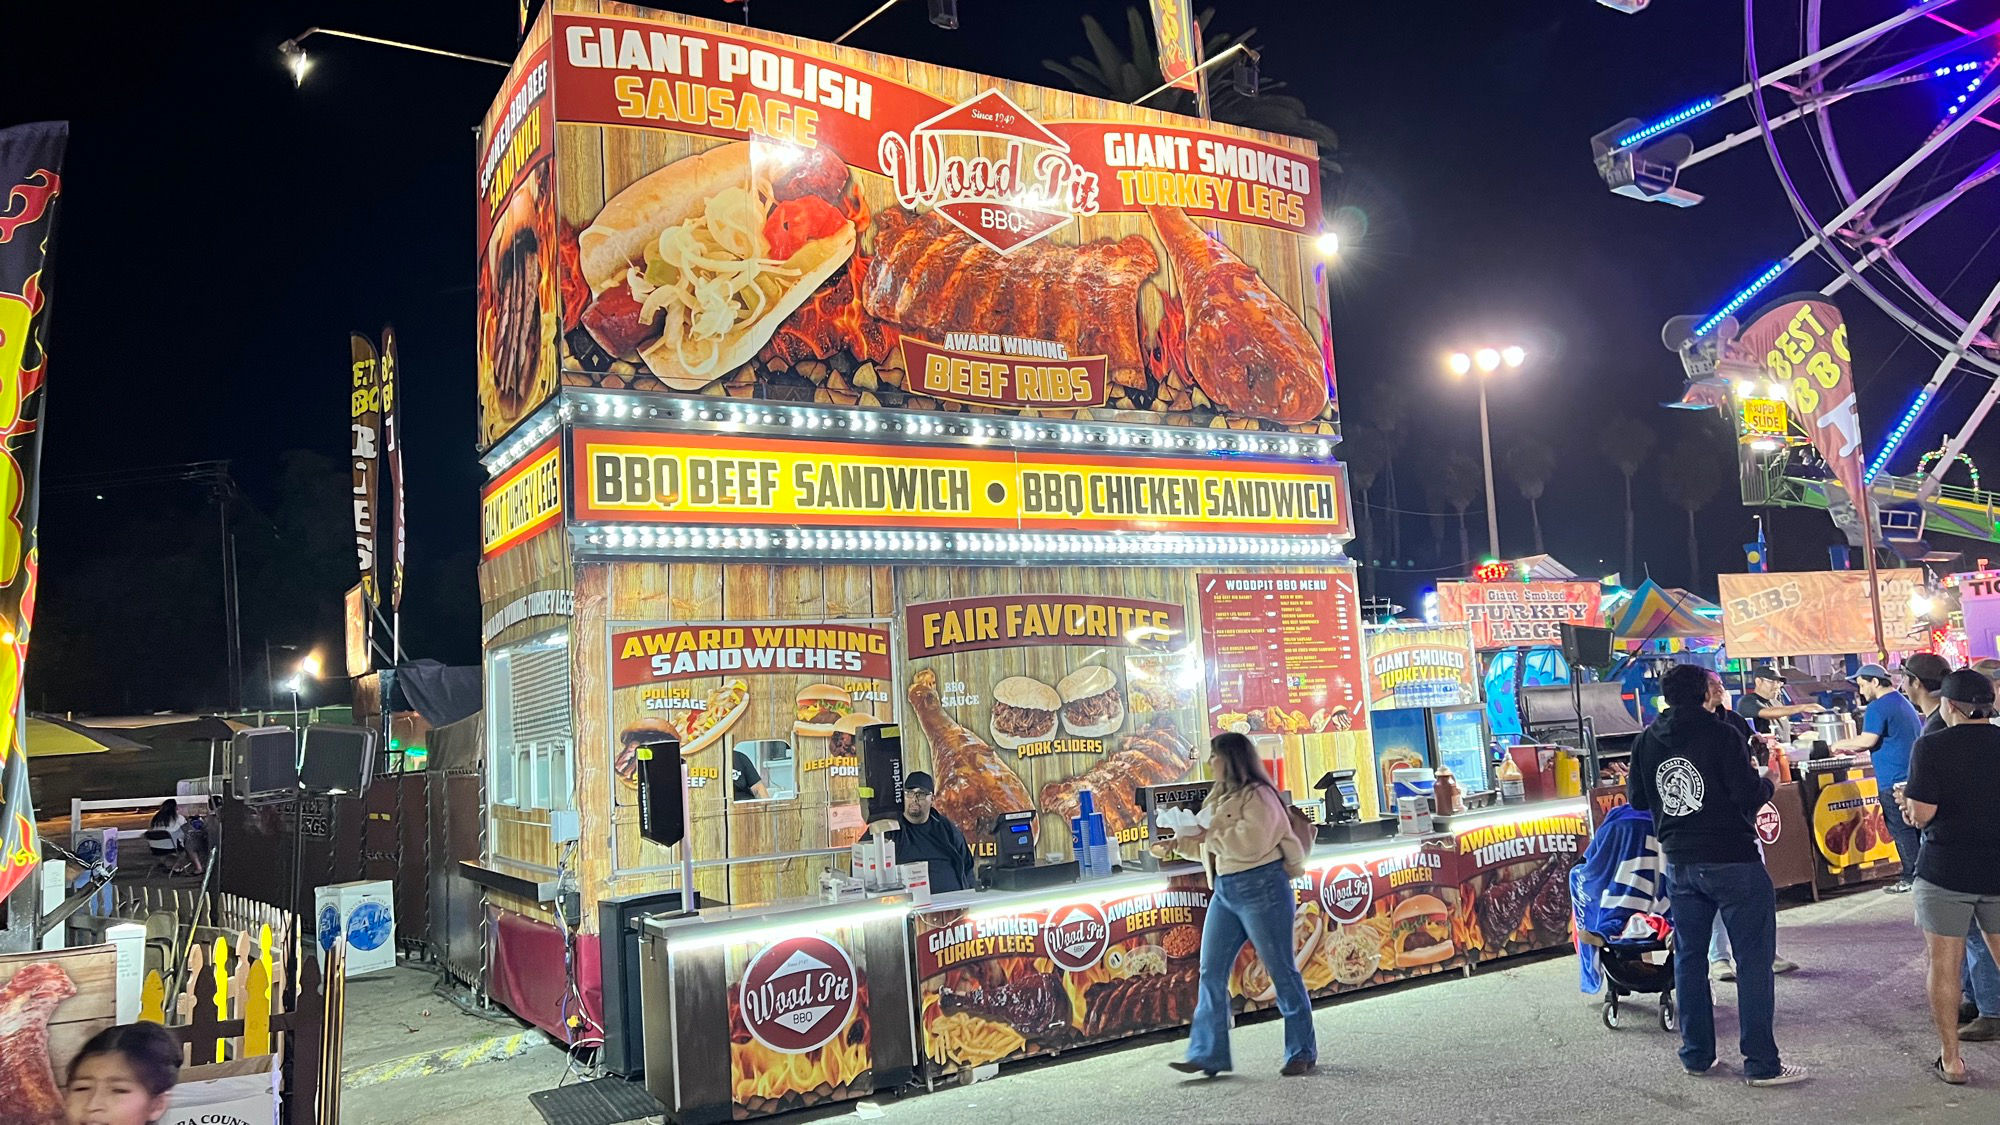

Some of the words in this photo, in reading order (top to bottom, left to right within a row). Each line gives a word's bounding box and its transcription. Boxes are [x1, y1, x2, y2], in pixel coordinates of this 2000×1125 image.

[565, 25, 709, 78] GIANT
[718, 43, 873, 120] POLISH
[614, 76, 819, 149] SAUSAGE
[971, 108, 993, 120] Since
[481, 113, 511, 199] SMOKED
[510, 84, 527, 132] BBQ
[528, 59, 548, 105] BEEF
[490, 106, 540, 219] SANDWICH
[878, 131, 1025, 210] Wood
[1034, 151, 1099, 216] Pit
[1104, 132, 1191, 168] GIANT
[1194, 138, 1310, 195] SMOKED
[1117, 168, 1232, 210] TURKEY
[1236, 183, 1306, 227] LEGS
[981, 207, 1022, 232] BBQ
[943, 333, 1000, 355] AWARD
[1002, 337, 1068, 361] WINNING
[1767, 303, 1826, 380] BEST
[924, 353, 1008, 400] BEEF
[1014, 365, 1092, 403] RIBS
[1753, 416, 1780, 429] SLIDE
[595, 455, 679, 507] BBQ
[689, 459, 779, 506] BEEF
[794, 463, 971, 511] SANDWICH
[1022, 472, 1083, 516] BBQ
[1091, 474, 1200, 516] CHICKEN
[1205, 479, 1334, 520] SANDWICH
[485, 495, 503, 545] GIANT
[505, 471, 534, 533] TURKEY
[537, 458, 558, 515] LEGS
[1225, 579, 1273, 591] WOODPIT
[1276, 579, 1298, 591] BBQ
[1300, 579, 1327, 591] MENU
[1488, 590, 1519, 602] Giant
[1524, 589, 1566, 602] Smoked
[1465, 603, 1588, 622] TURKEY
[1728, 581, 1802, 625] RIBS
[922, 607, 998, 649] FAIR
[1005, 603, 1170, 643] FAVORITES
[1492, 622, 1563, 641] LEGS
[620, 627, 744, 660] AWARD
[751, 627, 887, 655] WINNING
[651, 648, 863, 677] SANDWICHES
[1374, 650, 1410, 675] GIANT
[1412, 649, 1464, 669] SMOKED
[844, 682, 879, 693] GIANT
[944, 681, 964, 693] BBQ
[1379, 665, 1428, 691] TURKEY
[641, 688, 690, 701] POLISH
[646, 698, 707, 711] SAUSAGE
[941, 694, 980, 708] SAUCE
[1017, 741, 1052, 759] PORK
[1053, 739, 1103, 755] SLIDERS
[690, 768, 718, 780] BBQ
[804, 757, 834, 772] DEEP
[1156, 789, 1197, 804] HALF
[1460, 822, 1517, 856] AWARD
[1517, 816, 1587, 839] WINNING
[1428, 853, 1442, 868] LB
[1473, 836, 1536, 868] TURKEY
[1538, 834, 1577, 853] LEGS
[1390, 867, 1433, 889] BURGER
[1107, 895, 1152, 923] AWARD
[1153, 891, 1208, 910] WINNING
[1323, 881, 1353, 907] Wood
[1354, 879, 1368, 897] Pit
[1127, 909, 1158, 933] BEEF
[1161, 907, 1193, 925] RIBS
[928, 923, 974, 953] GIANT
[976, 917, 1039, 941] SMOKED
[1049, 923, 1086, 953] Wood
[1086, 921, 1105, 941] Pit
[935, 940, 996, 968] TURKEY
[998, 935, 1035, 955] LEGS
[747, 973, 813, 1025] Wood
[817, 972, 850, 1002] Pit
[793, 1011, 813, 1025] BBQ
